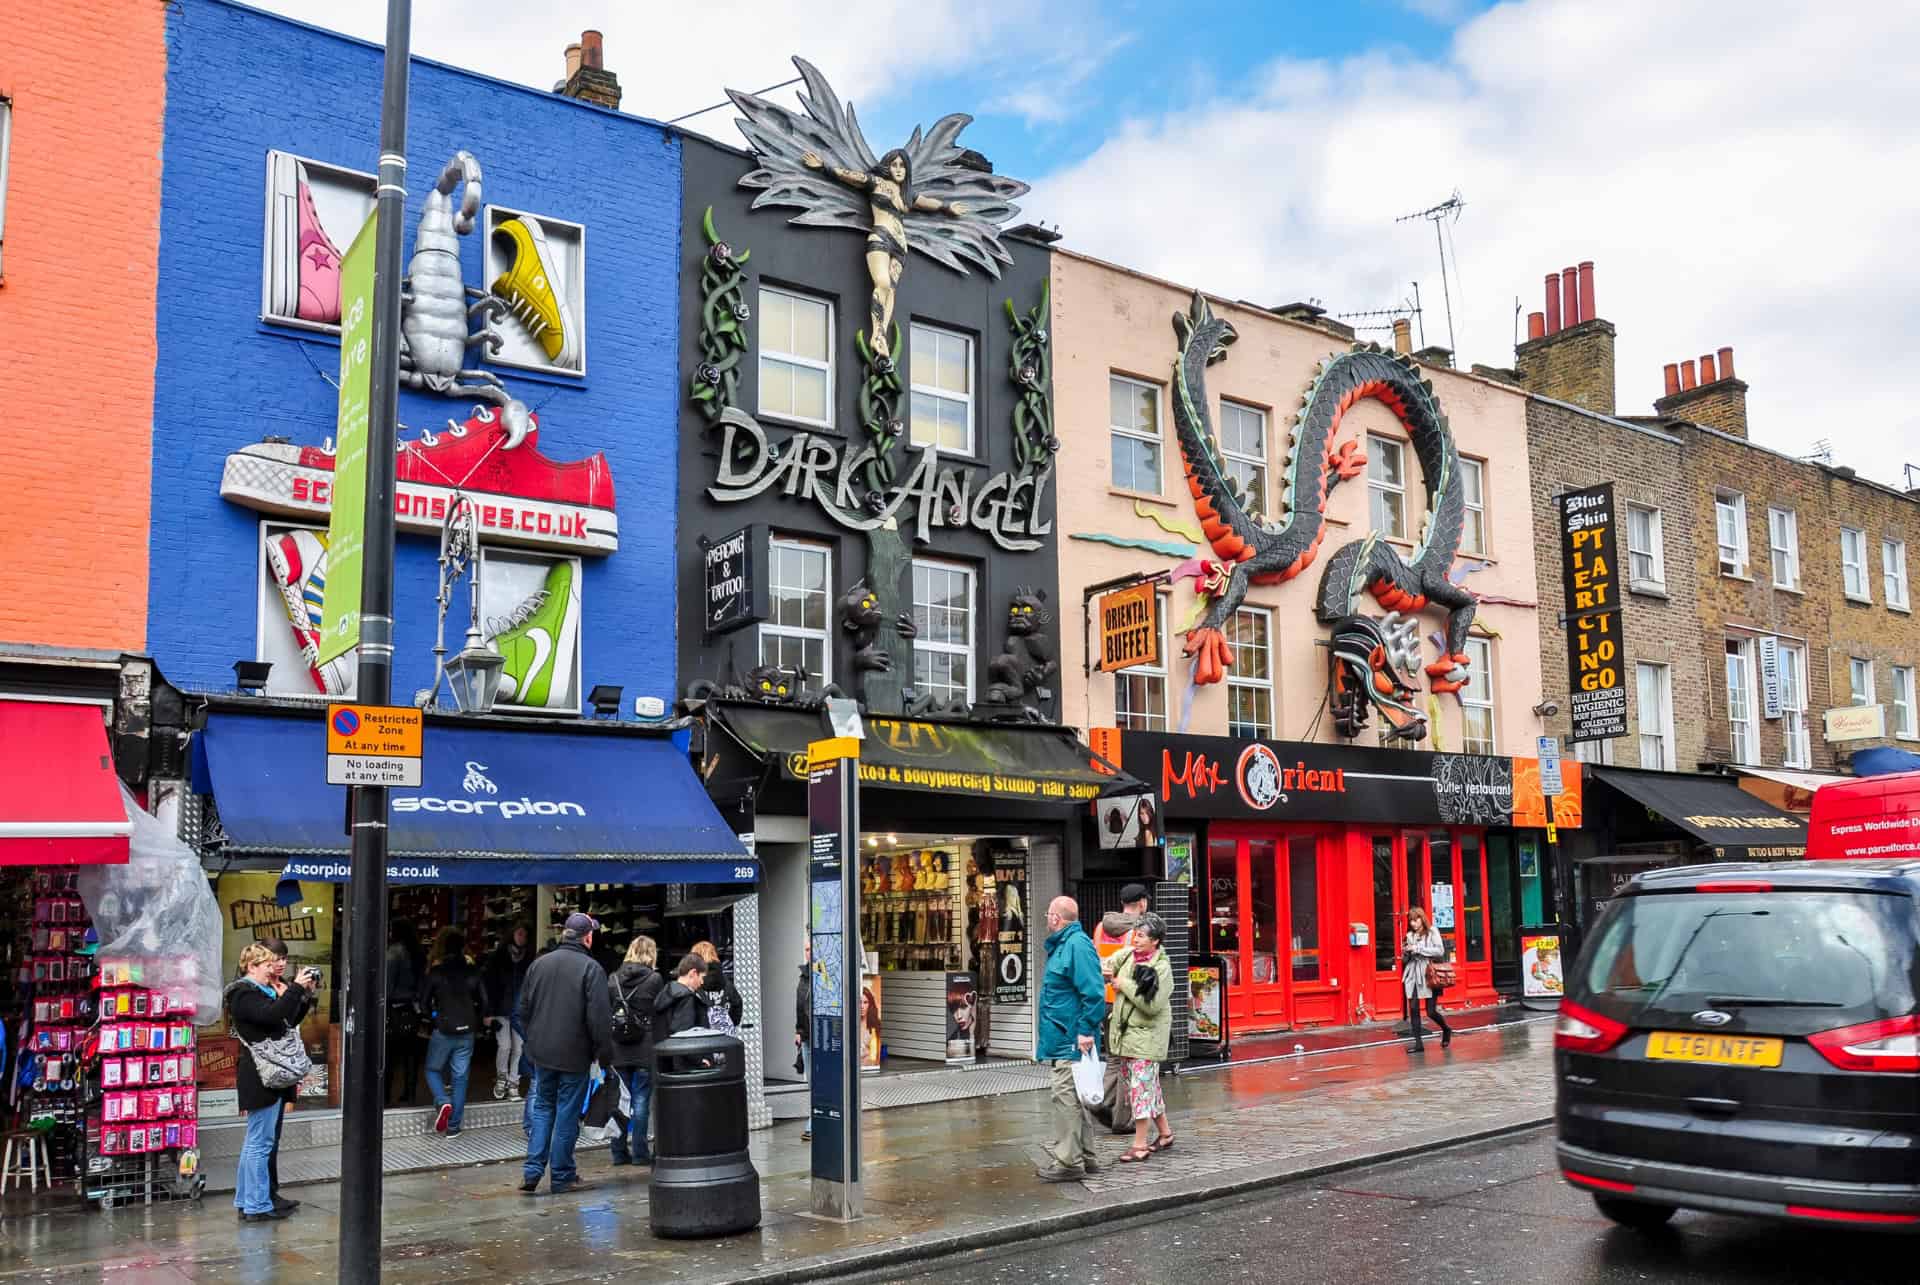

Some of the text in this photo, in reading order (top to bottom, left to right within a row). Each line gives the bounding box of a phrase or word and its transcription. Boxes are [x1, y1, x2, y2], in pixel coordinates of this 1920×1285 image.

[705, 406, 1052, 550] DARK ANGEL
[1566, 494, 1605, 513] Blue
[1568, 511, 1608, 533] Skin
[708, 535, 744, 568] PIERCING
[723, 561, 731, 577] &
[711, 576, 742, 602] TATTOO
[1105, 599, 1149, 631] ORIENTAL
[1590, 528, 1616, 688] TATTOO
[1106, 626, 1150, 664] BUFFET
[1574, 698, 1625, 713] HYGIENIC
[364, 712, 418, 725] Restricted
[1580, 716, 1620, 729] COLLECTION
[378, 725, 404, 736] Zone
[344, 740, 406, 752] At any time
[346, 760, 404, 772] No loading
[889, 766, 900, 782] &
[345, 772, 405, 782] at any time
[1162, 748, 1229, 802] Max
[391, 797, 586, 818] scorpion
[1831, 824, 1863, 836] Express
[1864, 819, 1910, 832] Worldwide
[734, 867, 754, 879] 269
